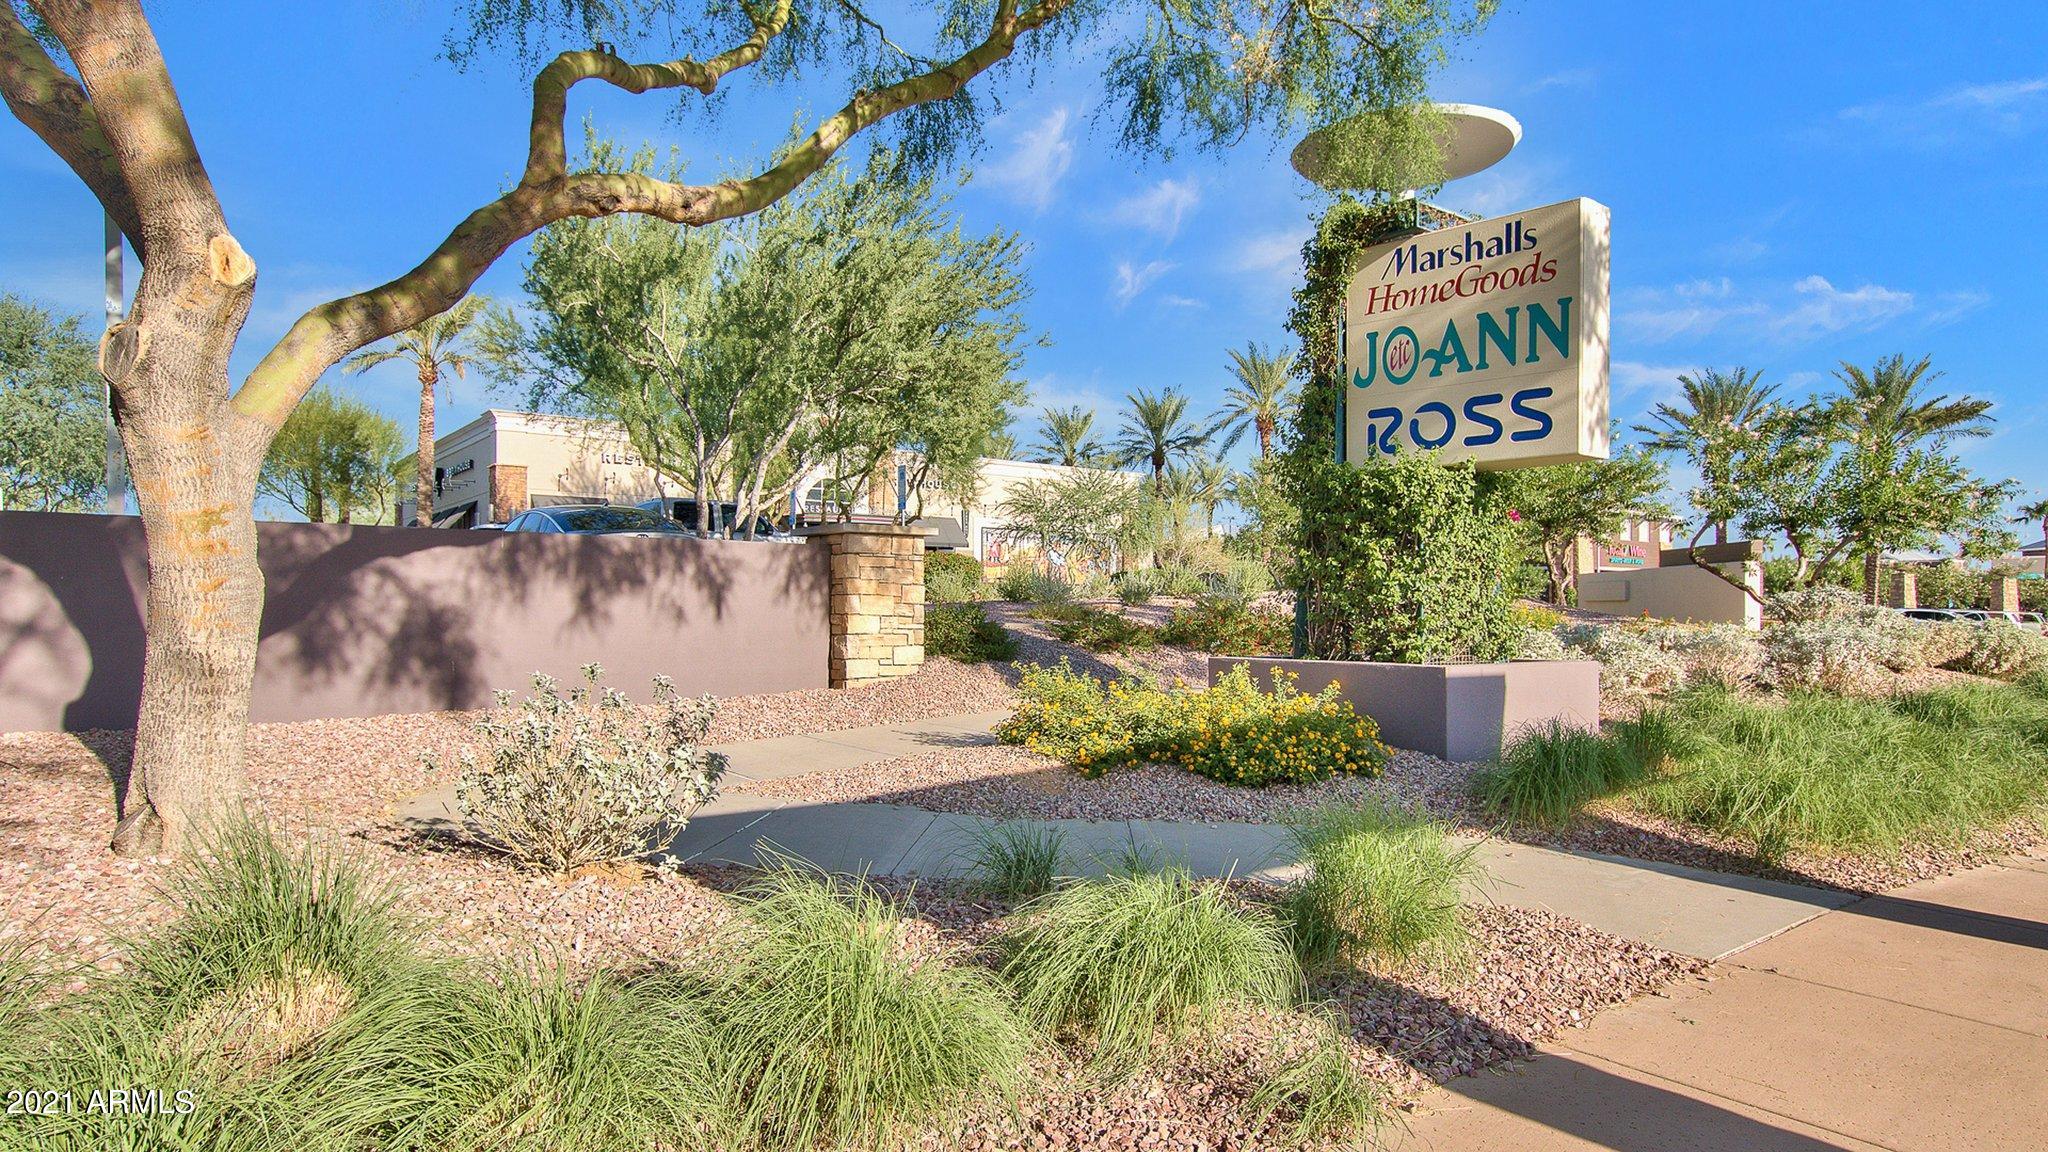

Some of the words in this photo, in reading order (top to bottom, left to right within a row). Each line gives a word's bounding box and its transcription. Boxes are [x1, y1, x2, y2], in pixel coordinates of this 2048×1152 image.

[1381, 220, 1538, 280] Marshalls
[1364, 251, 1558, 316] HomeGoods
[1353, 297, 1573, 389] JOANN
[1367, 387, 1553, 455] ROSS
